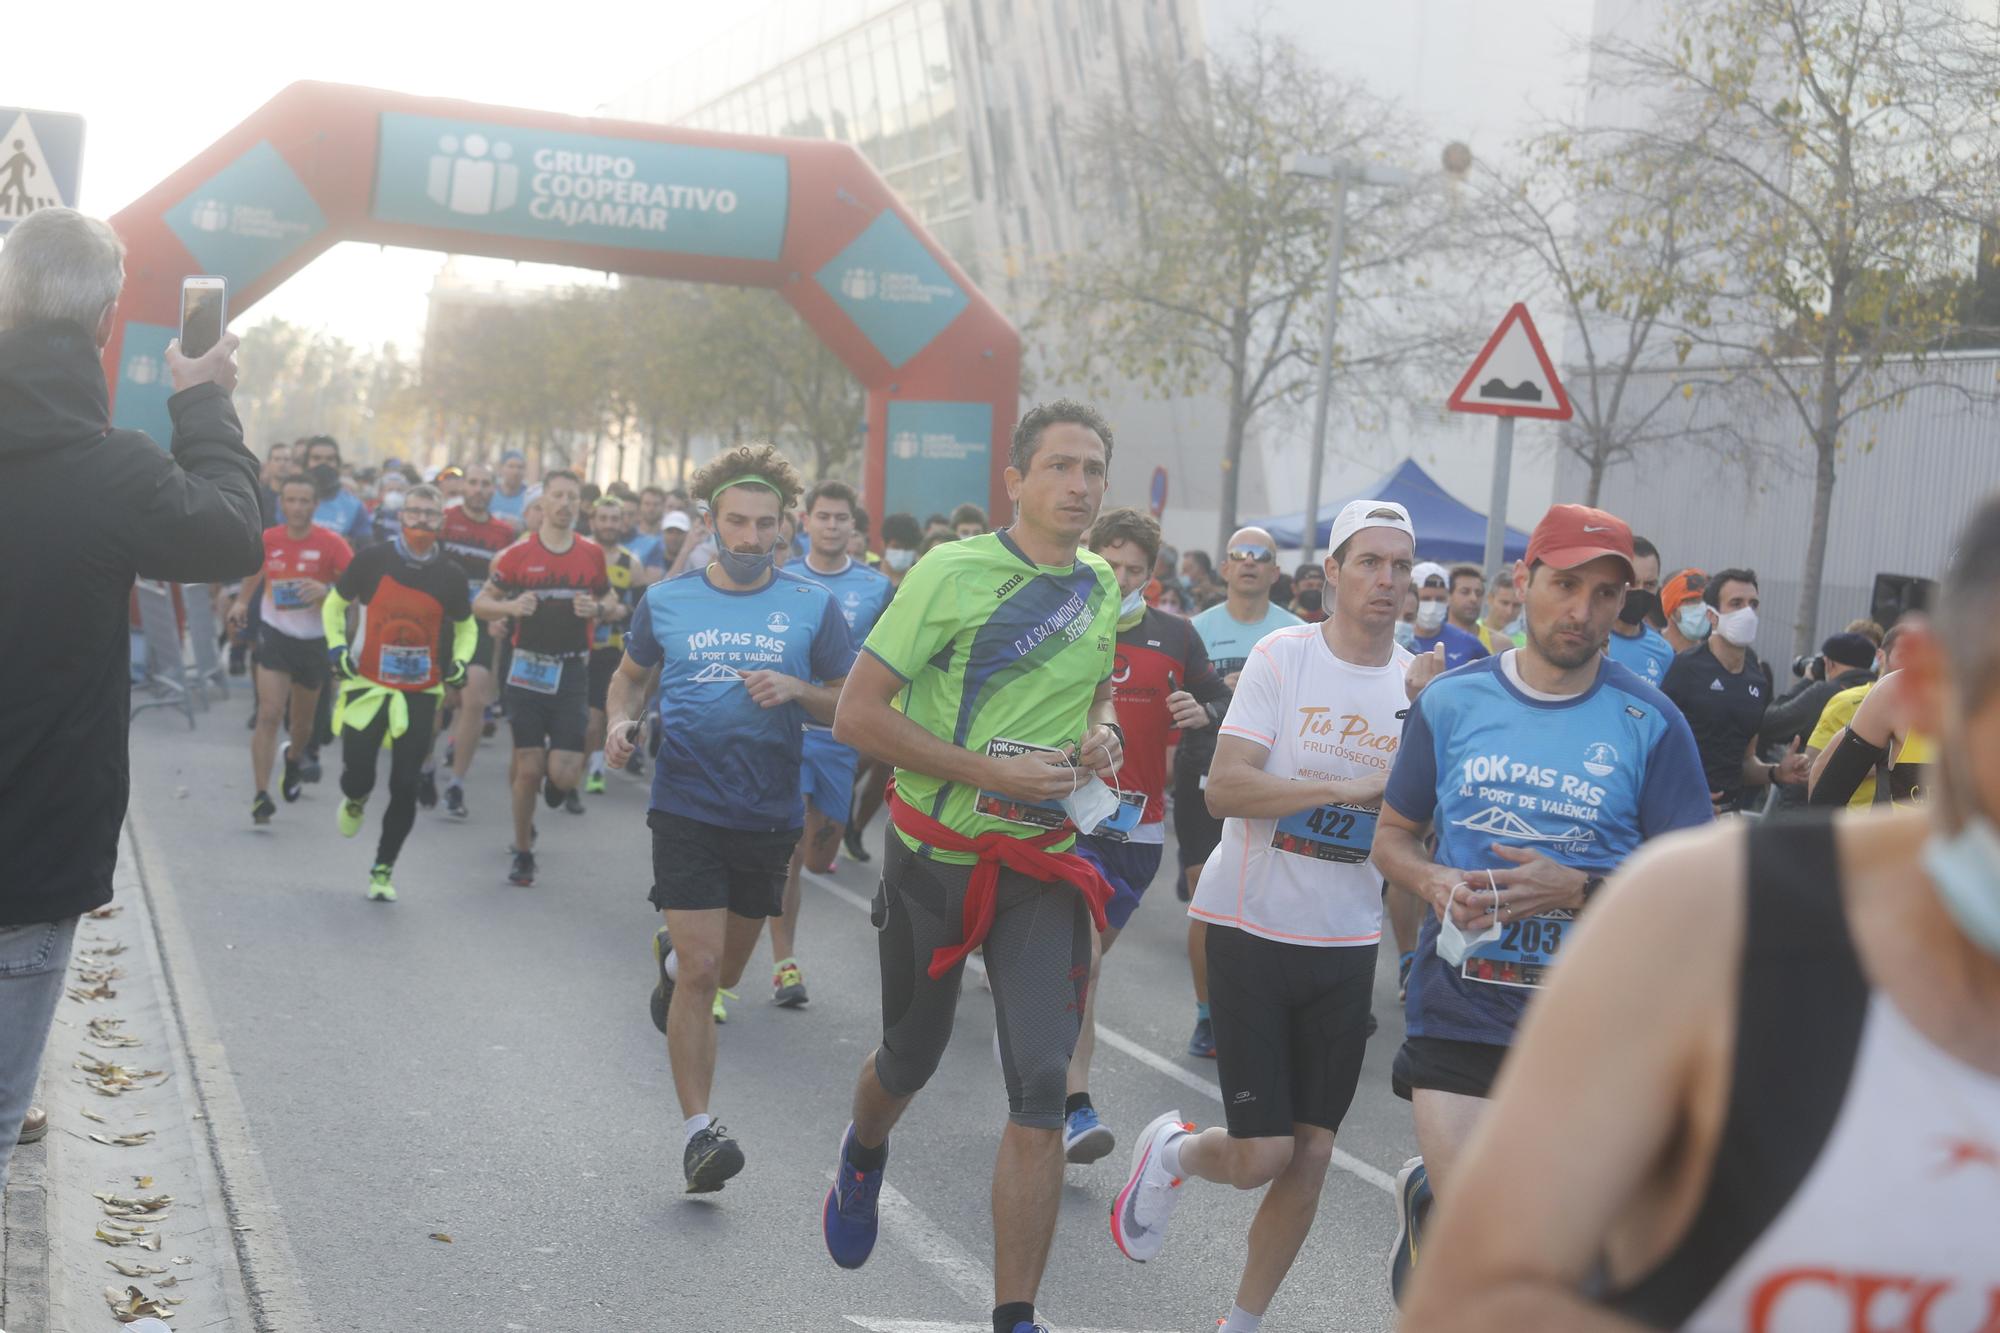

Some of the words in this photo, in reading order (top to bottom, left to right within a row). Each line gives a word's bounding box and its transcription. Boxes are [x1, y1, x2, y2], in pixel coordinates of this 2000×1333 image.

[533, 148, 636, 179] GRUPO
[531, 172, 738, 213] COOPERATIVO
[528, 197, 669, 231] CAJAMAR
[688, 628, 719, 650] 10K
[720, 632, 752, 646] PAS
[755, 634, 786, 653] RAS
[688, 651, 698, 661] AL
[702, 651, 726, 661] PORT
[730, 652, 741, 661] DE
[744, 650, 783, 663] VALÈNCIA
[992, 742, 1009, 752] 10K
[1009, 745, 1024, 753] PAS
[1340, 714, 1398, 752] Paco
[1463, 755, 1510, 785] 10K
[1510, 762, 1558, 788] PAS
[1561, 775, 1606, 807] RAS
[1459, 784, 1474, 797] AL
[1479, 787, 1515, 805] PORT
[1519, 795, 1537, 809] DE
[1542, 799, 1598, 821] VALÈNCIA
[1306, 808, 1356, 840] 422
[1501, 920, 1562, 955] 203
